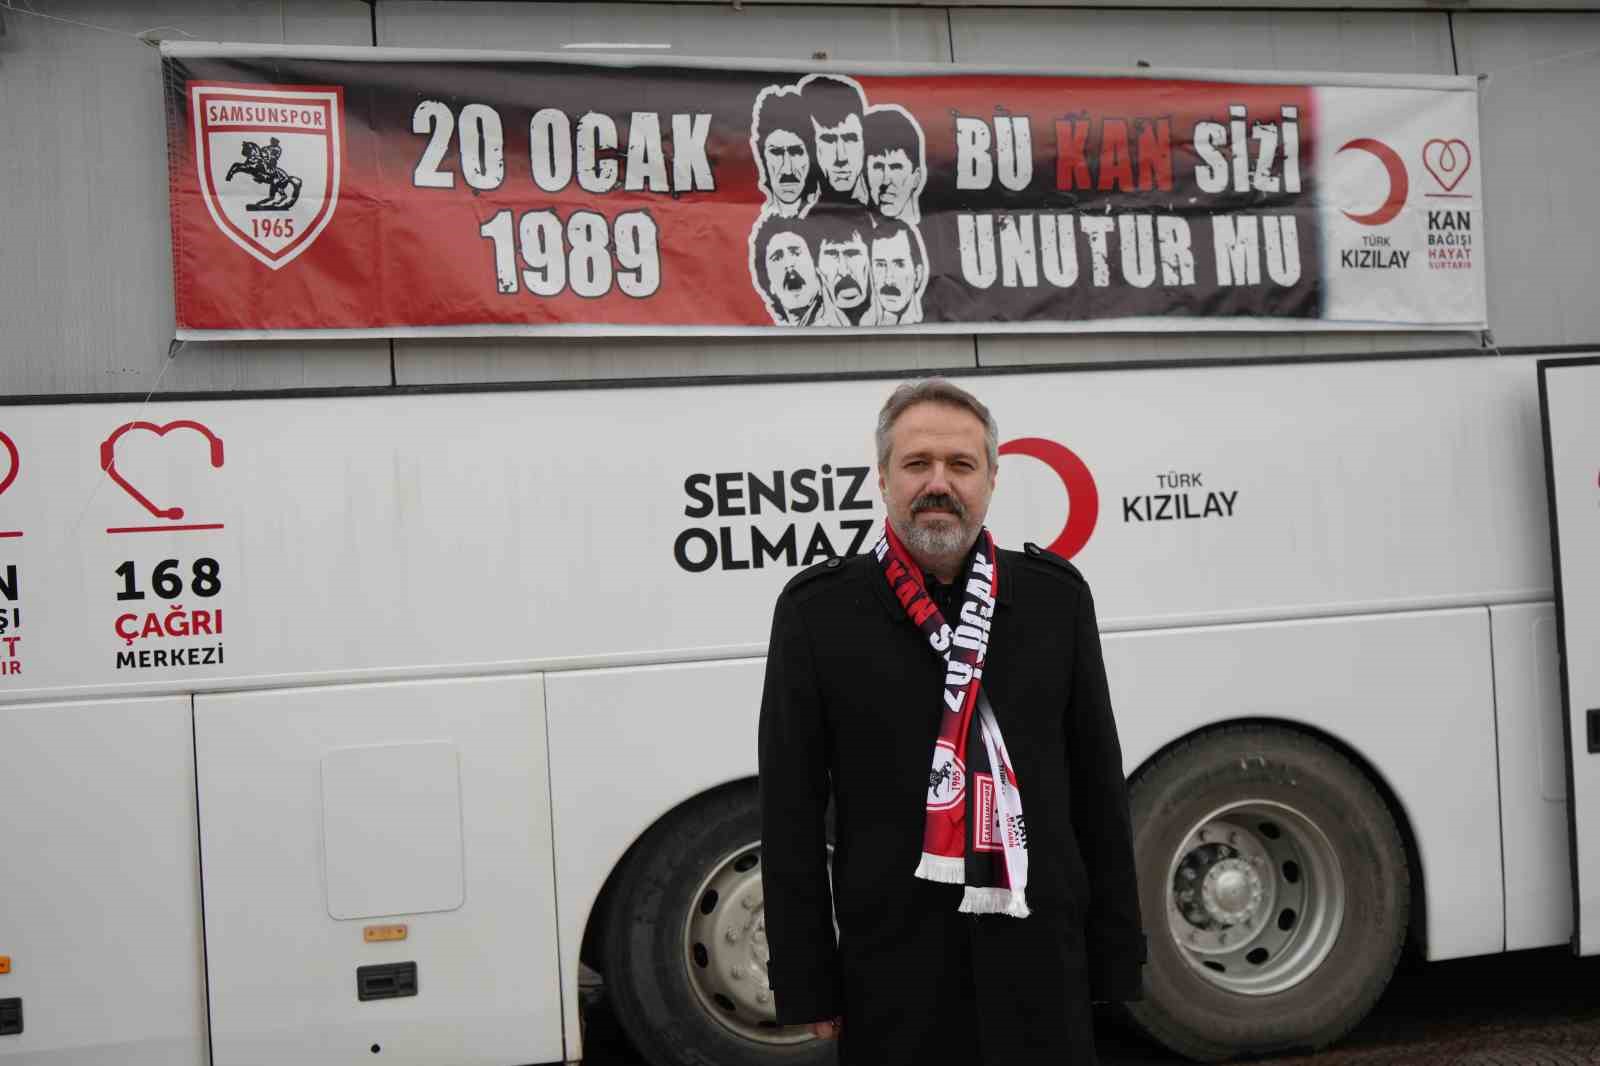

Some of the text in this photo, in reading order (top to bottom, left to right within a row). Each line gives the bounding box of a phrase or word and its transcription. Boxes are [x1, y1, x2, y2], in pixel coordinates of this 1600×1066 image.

[209, 106, 322, 126] SAMSUNSPOR
[412, 99, 716, 193] 20 OCAK
[956, 105, 1301, 193] BU KAN SİZİ
[251, 218, 294, 238] 1965
[1428, 210, 1470, 231] KAN
[480, 209, 661, 298] 1989
[957, 213, 1301, 288] UNUTUR MU
[1361, 234, 1391, 247] TÜRK
[1428, 248, 1472, 260] HAYAT
[1341, 249, 1410, 269] KIZILAY
[1156, 471, 1203, 489] TÜRK
[1122, 490, 1238, 522] KIZILAY
[674, 519, 874, 573] OLMAZ
[115, 557, 222, 601] 168
[885, 559, 938, 625] KAN
[114, 604, 223, 646] ÇAĞRI
[116, 642, 224, 669] MERKEZİ
[952, 770, 961, 791] 1965
